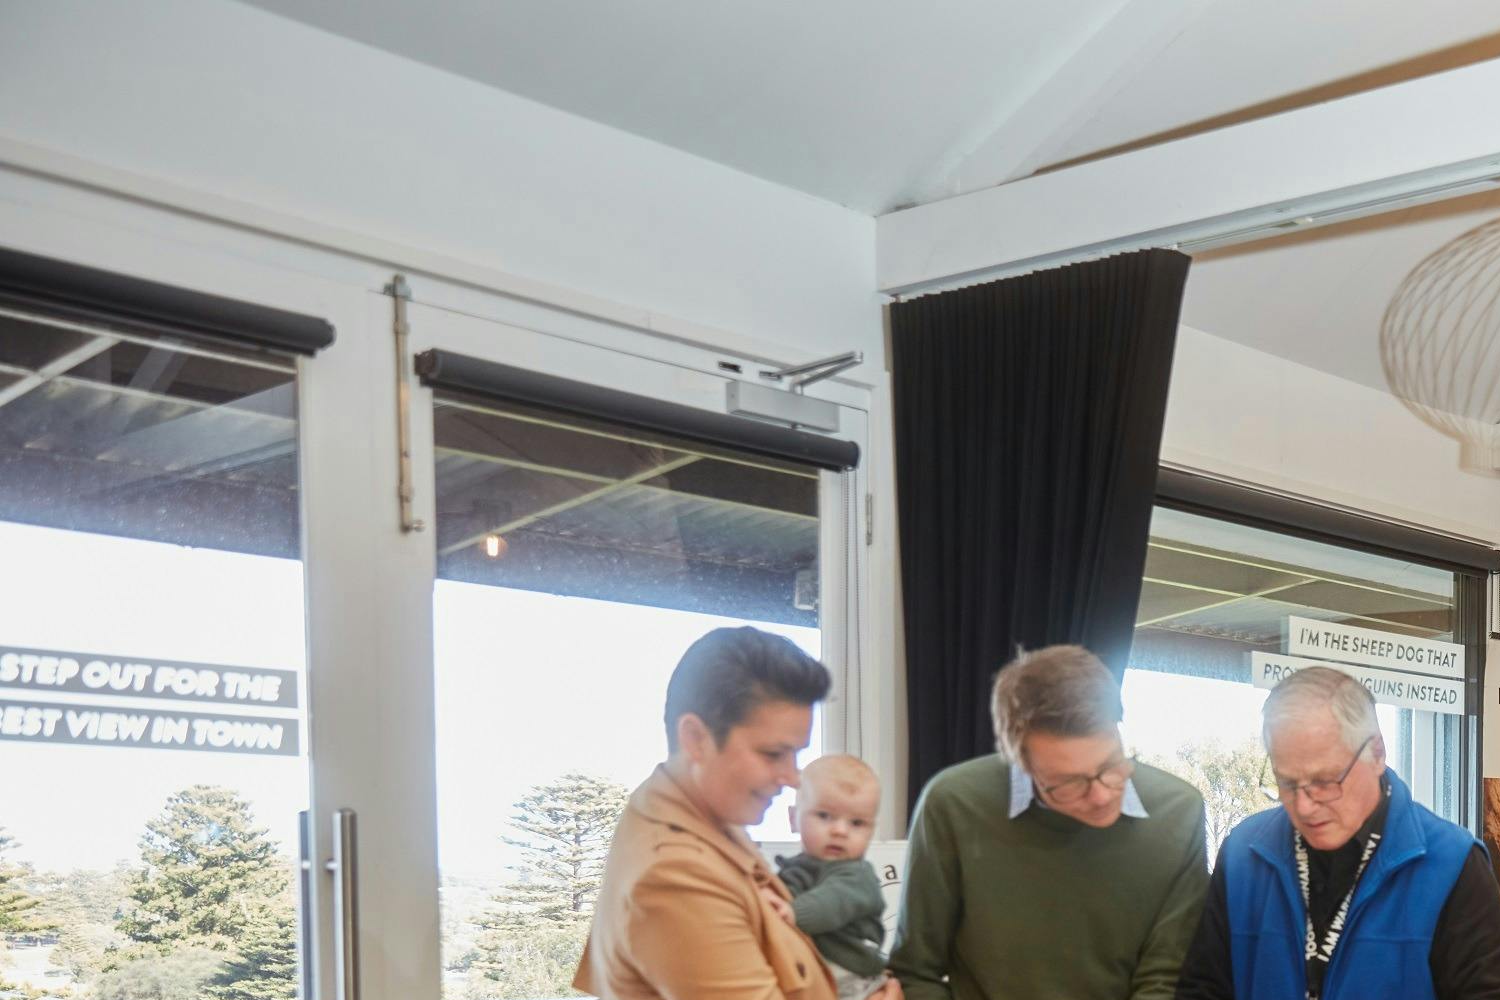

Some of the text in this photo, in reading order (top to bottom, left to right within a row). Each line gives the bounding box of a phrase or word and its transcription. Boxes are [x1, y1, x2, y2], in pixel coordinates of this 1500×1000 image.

[1300, 627, 1457, 668] I'M THE SHEEP DOG THAT
[0, 652, 281, 701] STEP OUT FOR THE
[1264, 663, 1298, 681] PRO
[1406, 685, 1457, 705] INSTEAD
[0, 705, 283, 749] EST VIEW IN TOWN
